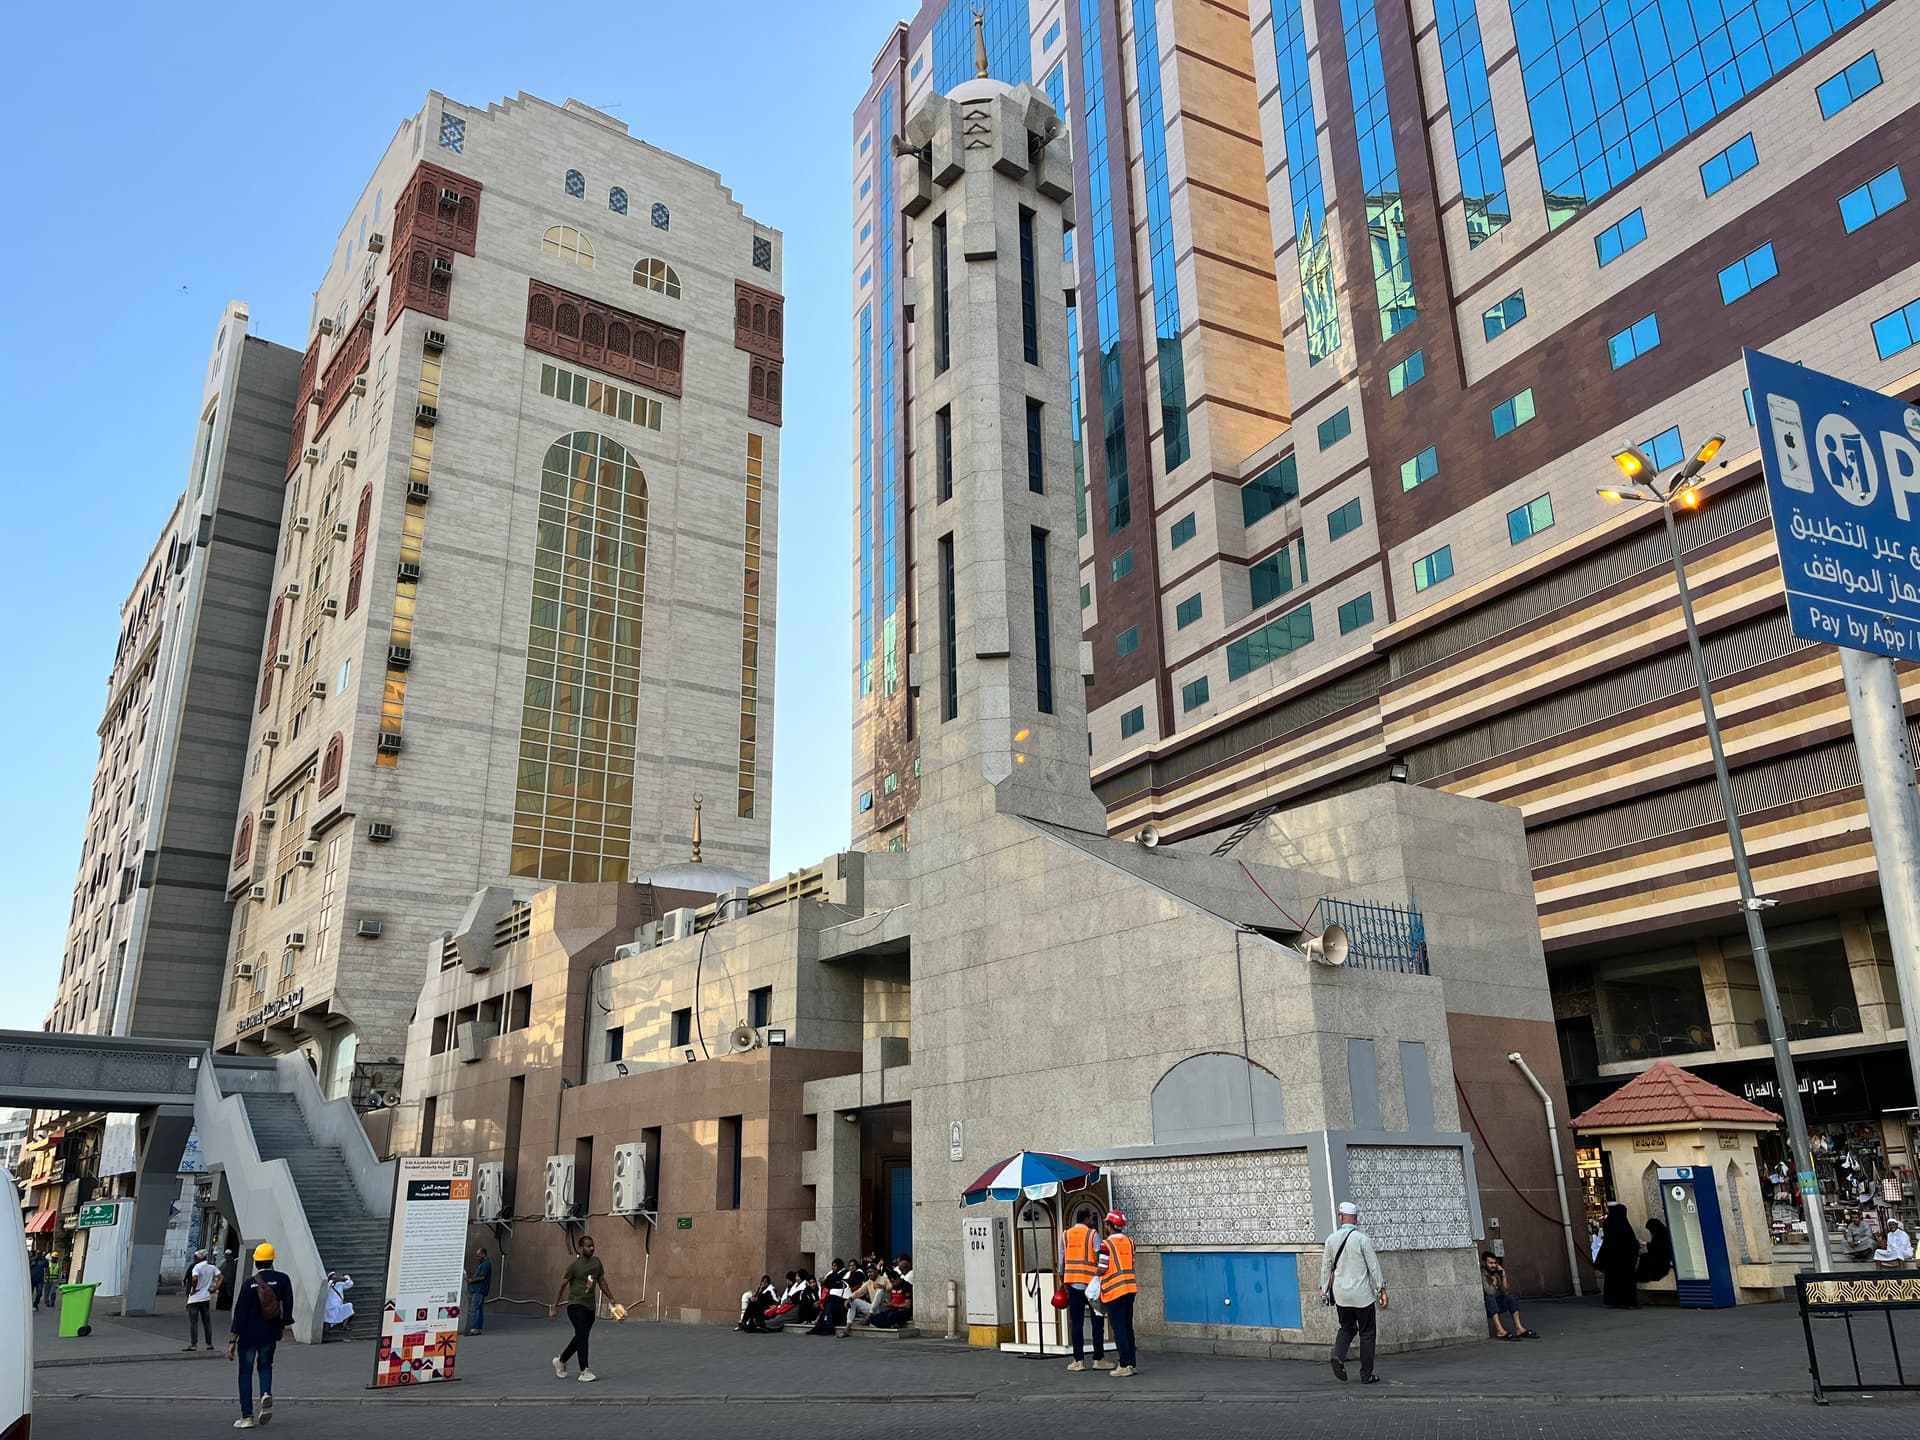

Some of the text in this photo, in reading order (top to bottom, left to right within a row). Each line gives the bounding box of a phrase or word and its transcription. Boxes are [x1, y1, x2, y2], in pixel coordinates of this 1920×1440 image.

[1880, 431, 1920, 522] P
[1790, 508, 1868, 550] التطبيق
[1873, 535, 1905, 563] عبر
[1804, 554, 1883, 594] المواقف
[1809, 607, 1840, 638] Pay
[1847, 614, 1868, 643] by
[1873, 621, 1905, 651] App
[1743, 1081, 1775, 1101] الهدايا
[971, 1240, 985, 1250] 004
